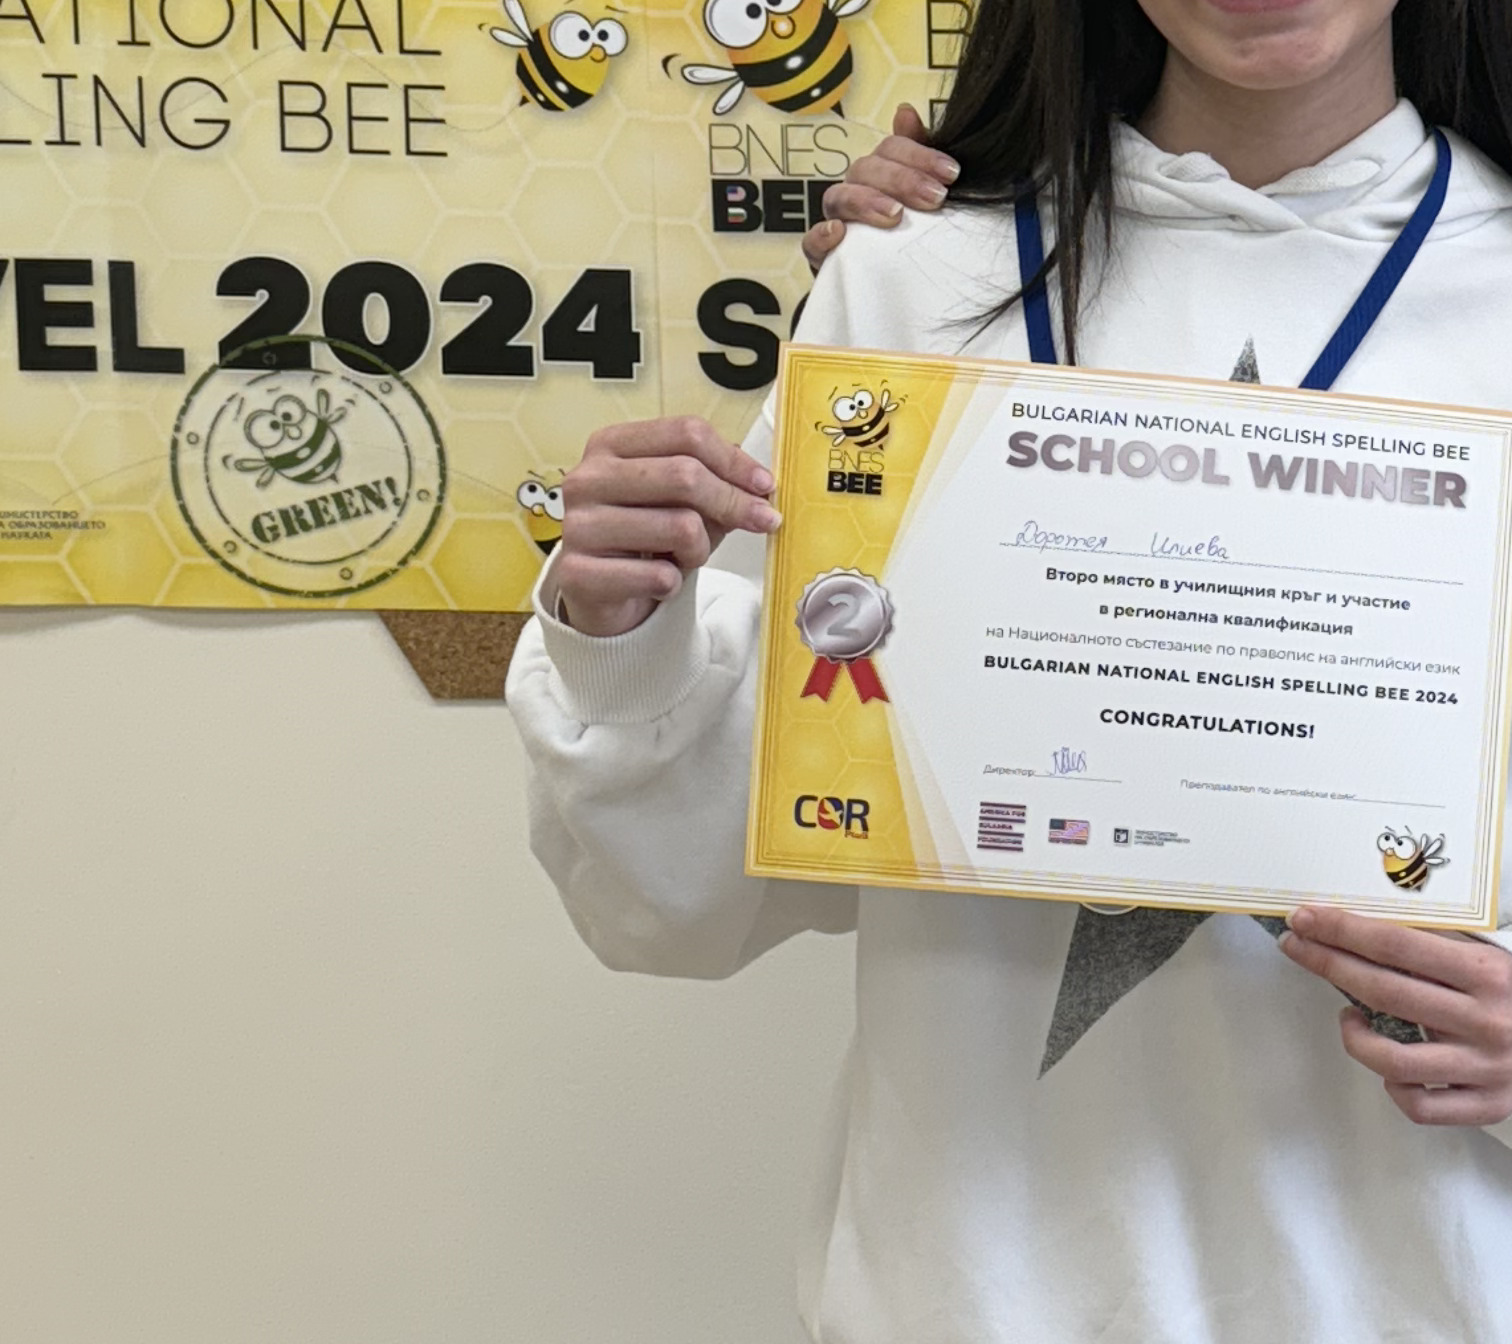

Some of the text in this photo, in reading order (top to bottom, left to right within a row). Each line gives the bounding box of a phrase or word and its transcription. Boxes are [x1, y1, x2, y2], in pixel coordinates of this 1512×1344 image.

[279, 80, 448, 157] BEE
[709, 123, 850, 177] BNES
[0, 257, 186, 374] EL
[215, 256, 641, 380] 2024
[1012, 403, 1470, 461] BULGARIAN NATIONAL ENGLISH SPELLING BEE
[827, 470, 882, 496] BEE
[828, 449, 885, 472] BNES
[1006, 431, 1467, 509] SCHOOL WINNER
[251, 475, 402, 546] GREEN!
[1016, 520, 1230, 559] Доротея Илиева
[1046, 567, 1411, 610] Второ място в училищния кръг и участие
[827, 593, 862, 637] 2
[1099, 604, 1353, 636] в регионална квалификация
[986, 626, 1461, 675] на Националното състезание по правопис на английски език
[984, 655, 1458, 705] BULGARIAN NATIONAL ENGLISH SPELLING BEE 2024
[1100, 708, 1315, 739] CONGRATULATIONS!
